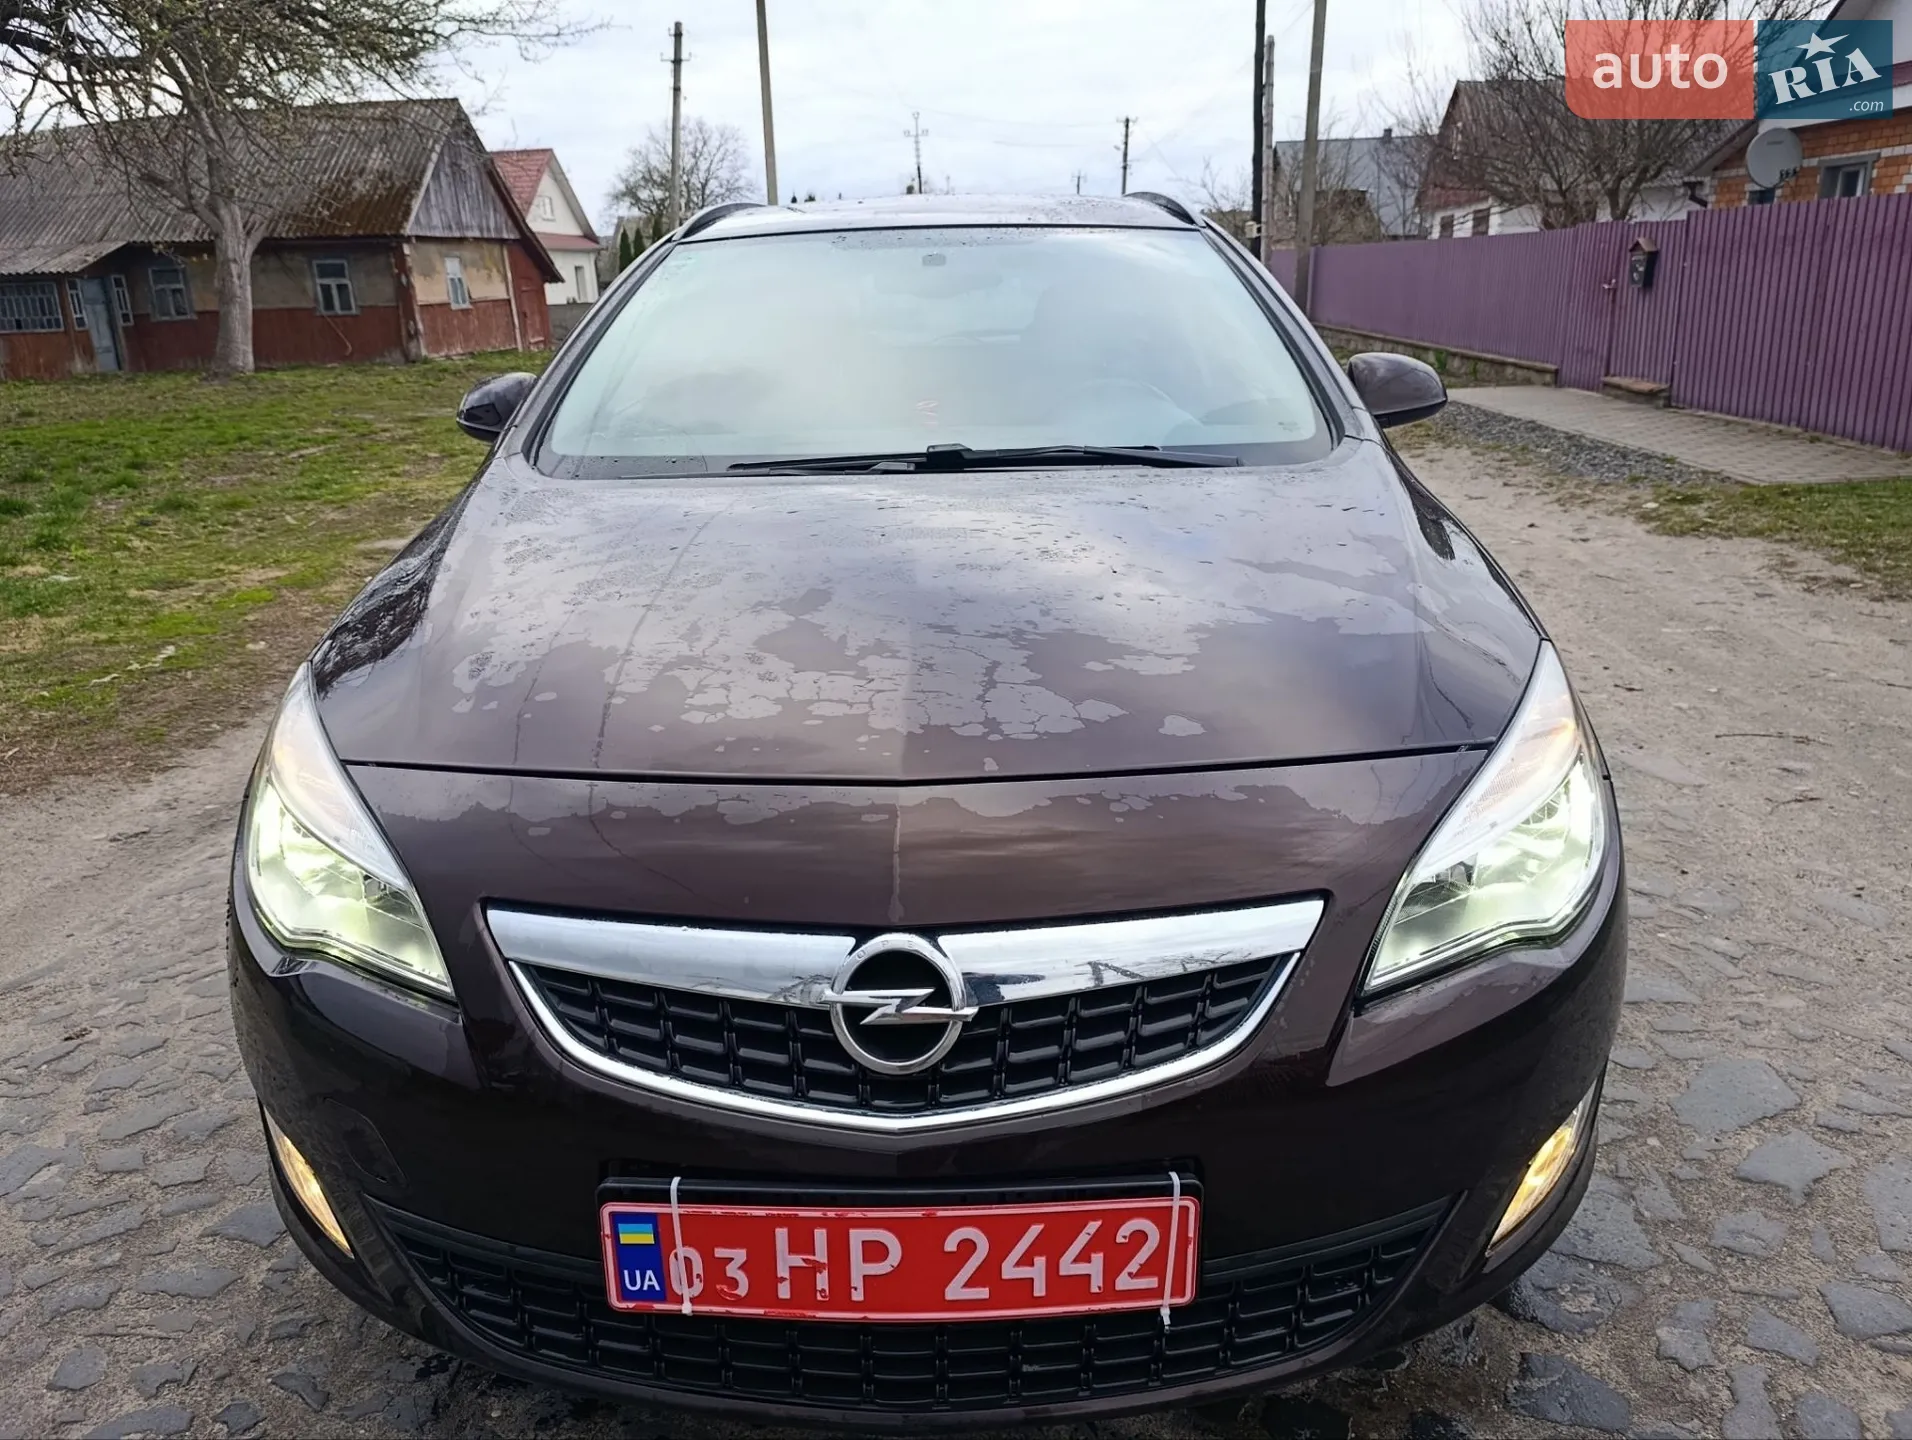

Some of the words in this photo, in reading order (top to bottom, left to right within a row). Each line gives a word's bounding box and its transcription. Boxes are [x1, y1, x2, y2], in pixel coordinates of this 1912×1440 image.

[623, 1269, 661, 1291] UA
[774, 1227, 901, 1301] HP
[943, 1218, 1160, 1300] 2442
